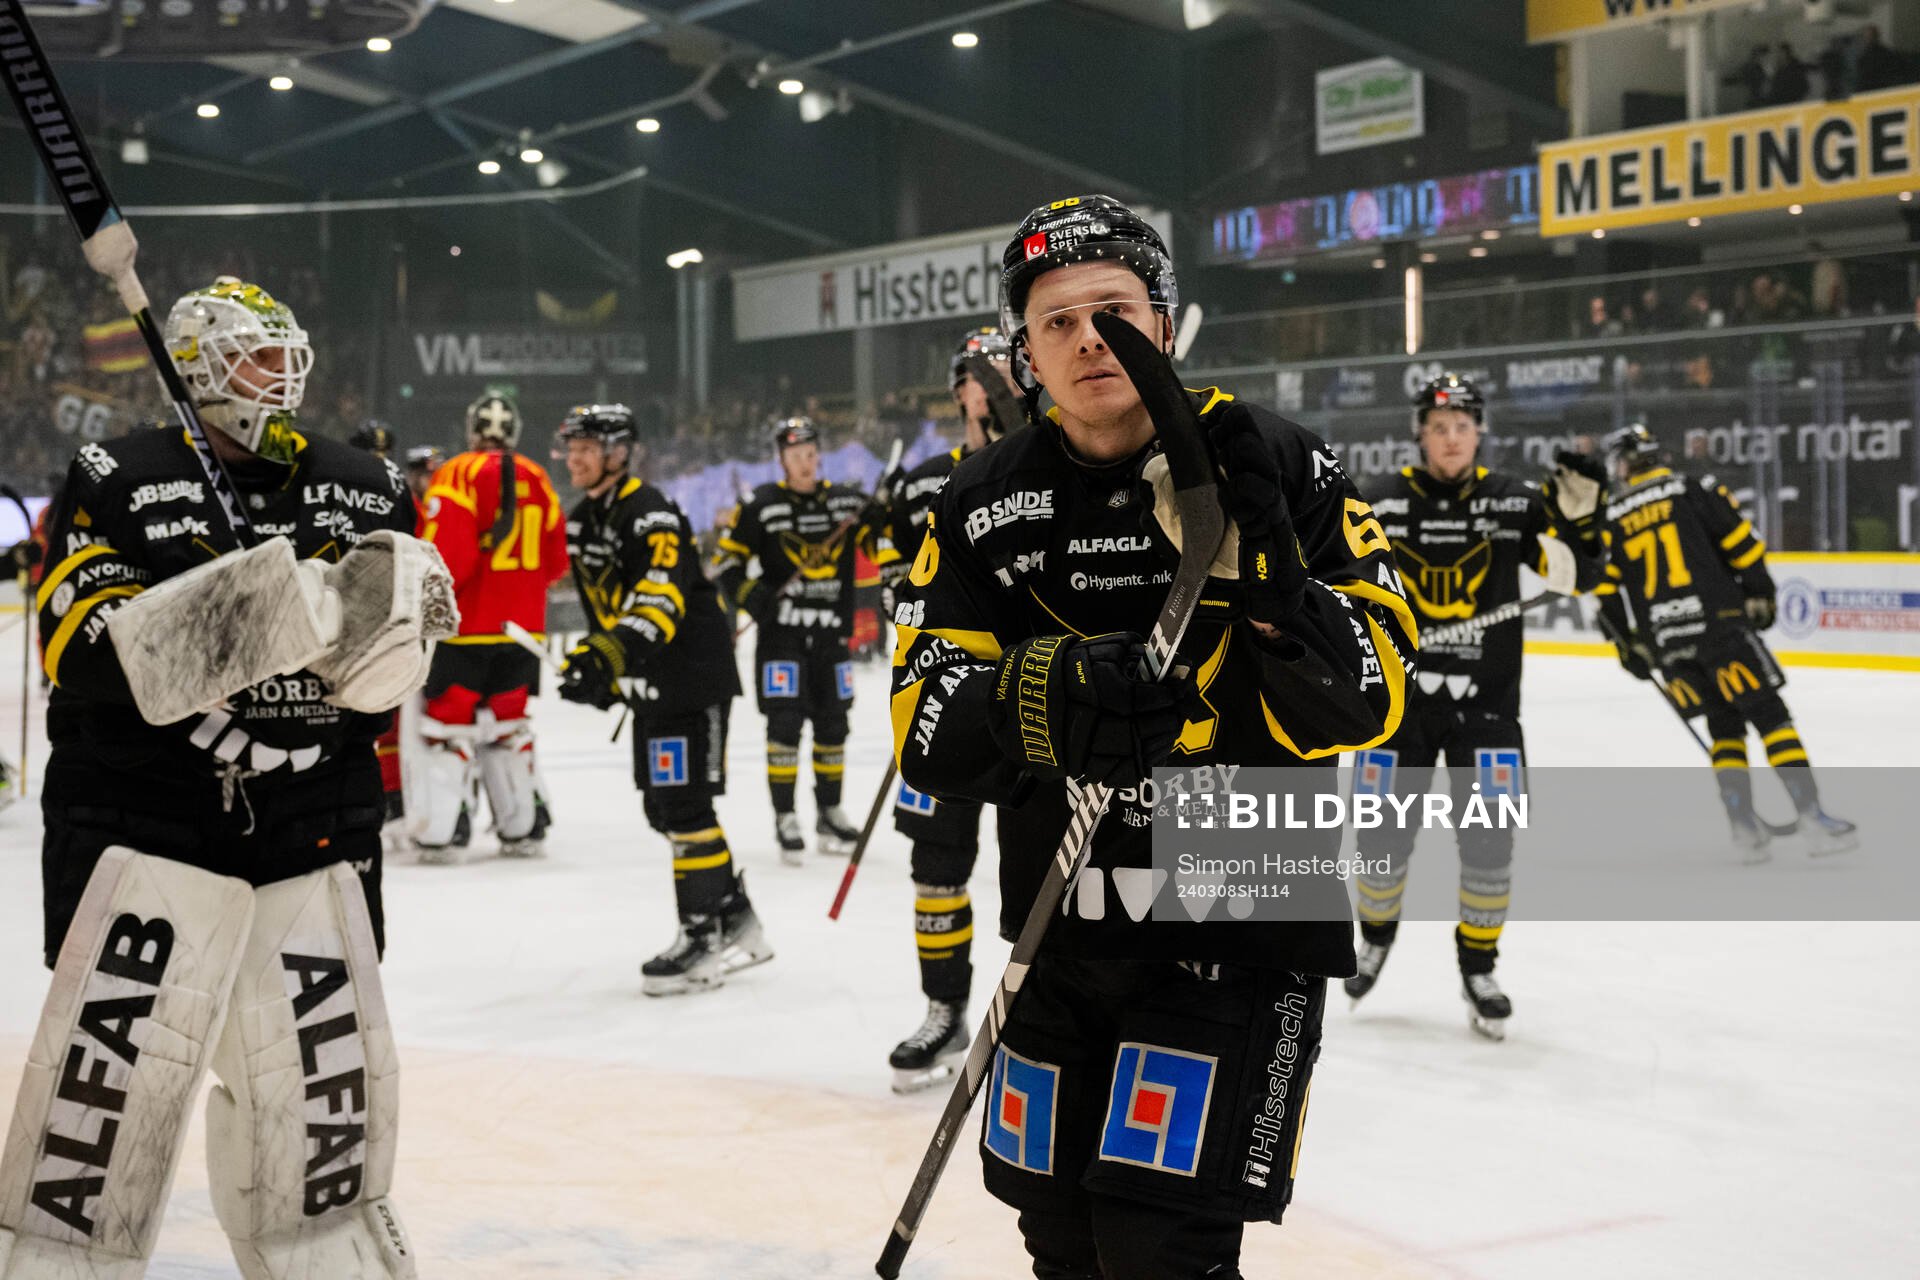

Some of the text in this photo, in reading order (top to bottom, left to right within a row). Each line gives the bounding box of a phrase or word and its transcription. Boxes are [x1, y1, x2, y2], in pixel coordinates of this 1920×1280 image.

[0, 0, 101, 204] WARRIO
[1556, 108, 1920, 217] MELLINGE
[1049, 224, 1108, 243] SVENSKA
[1684, 418, 1789, 465] notar
[1797, 413, 1911, 463] notar
[1623, 522, 1692, 599] 71
[915, 695, 943, 756] JAN
[1018, 637, 1058, 767] WARRIO
[30, 912, 175, 1237] ALFAB
[281, 951, 366, 1217] ALFAB
[1248, 992, 1307, 1162] Hisstech
